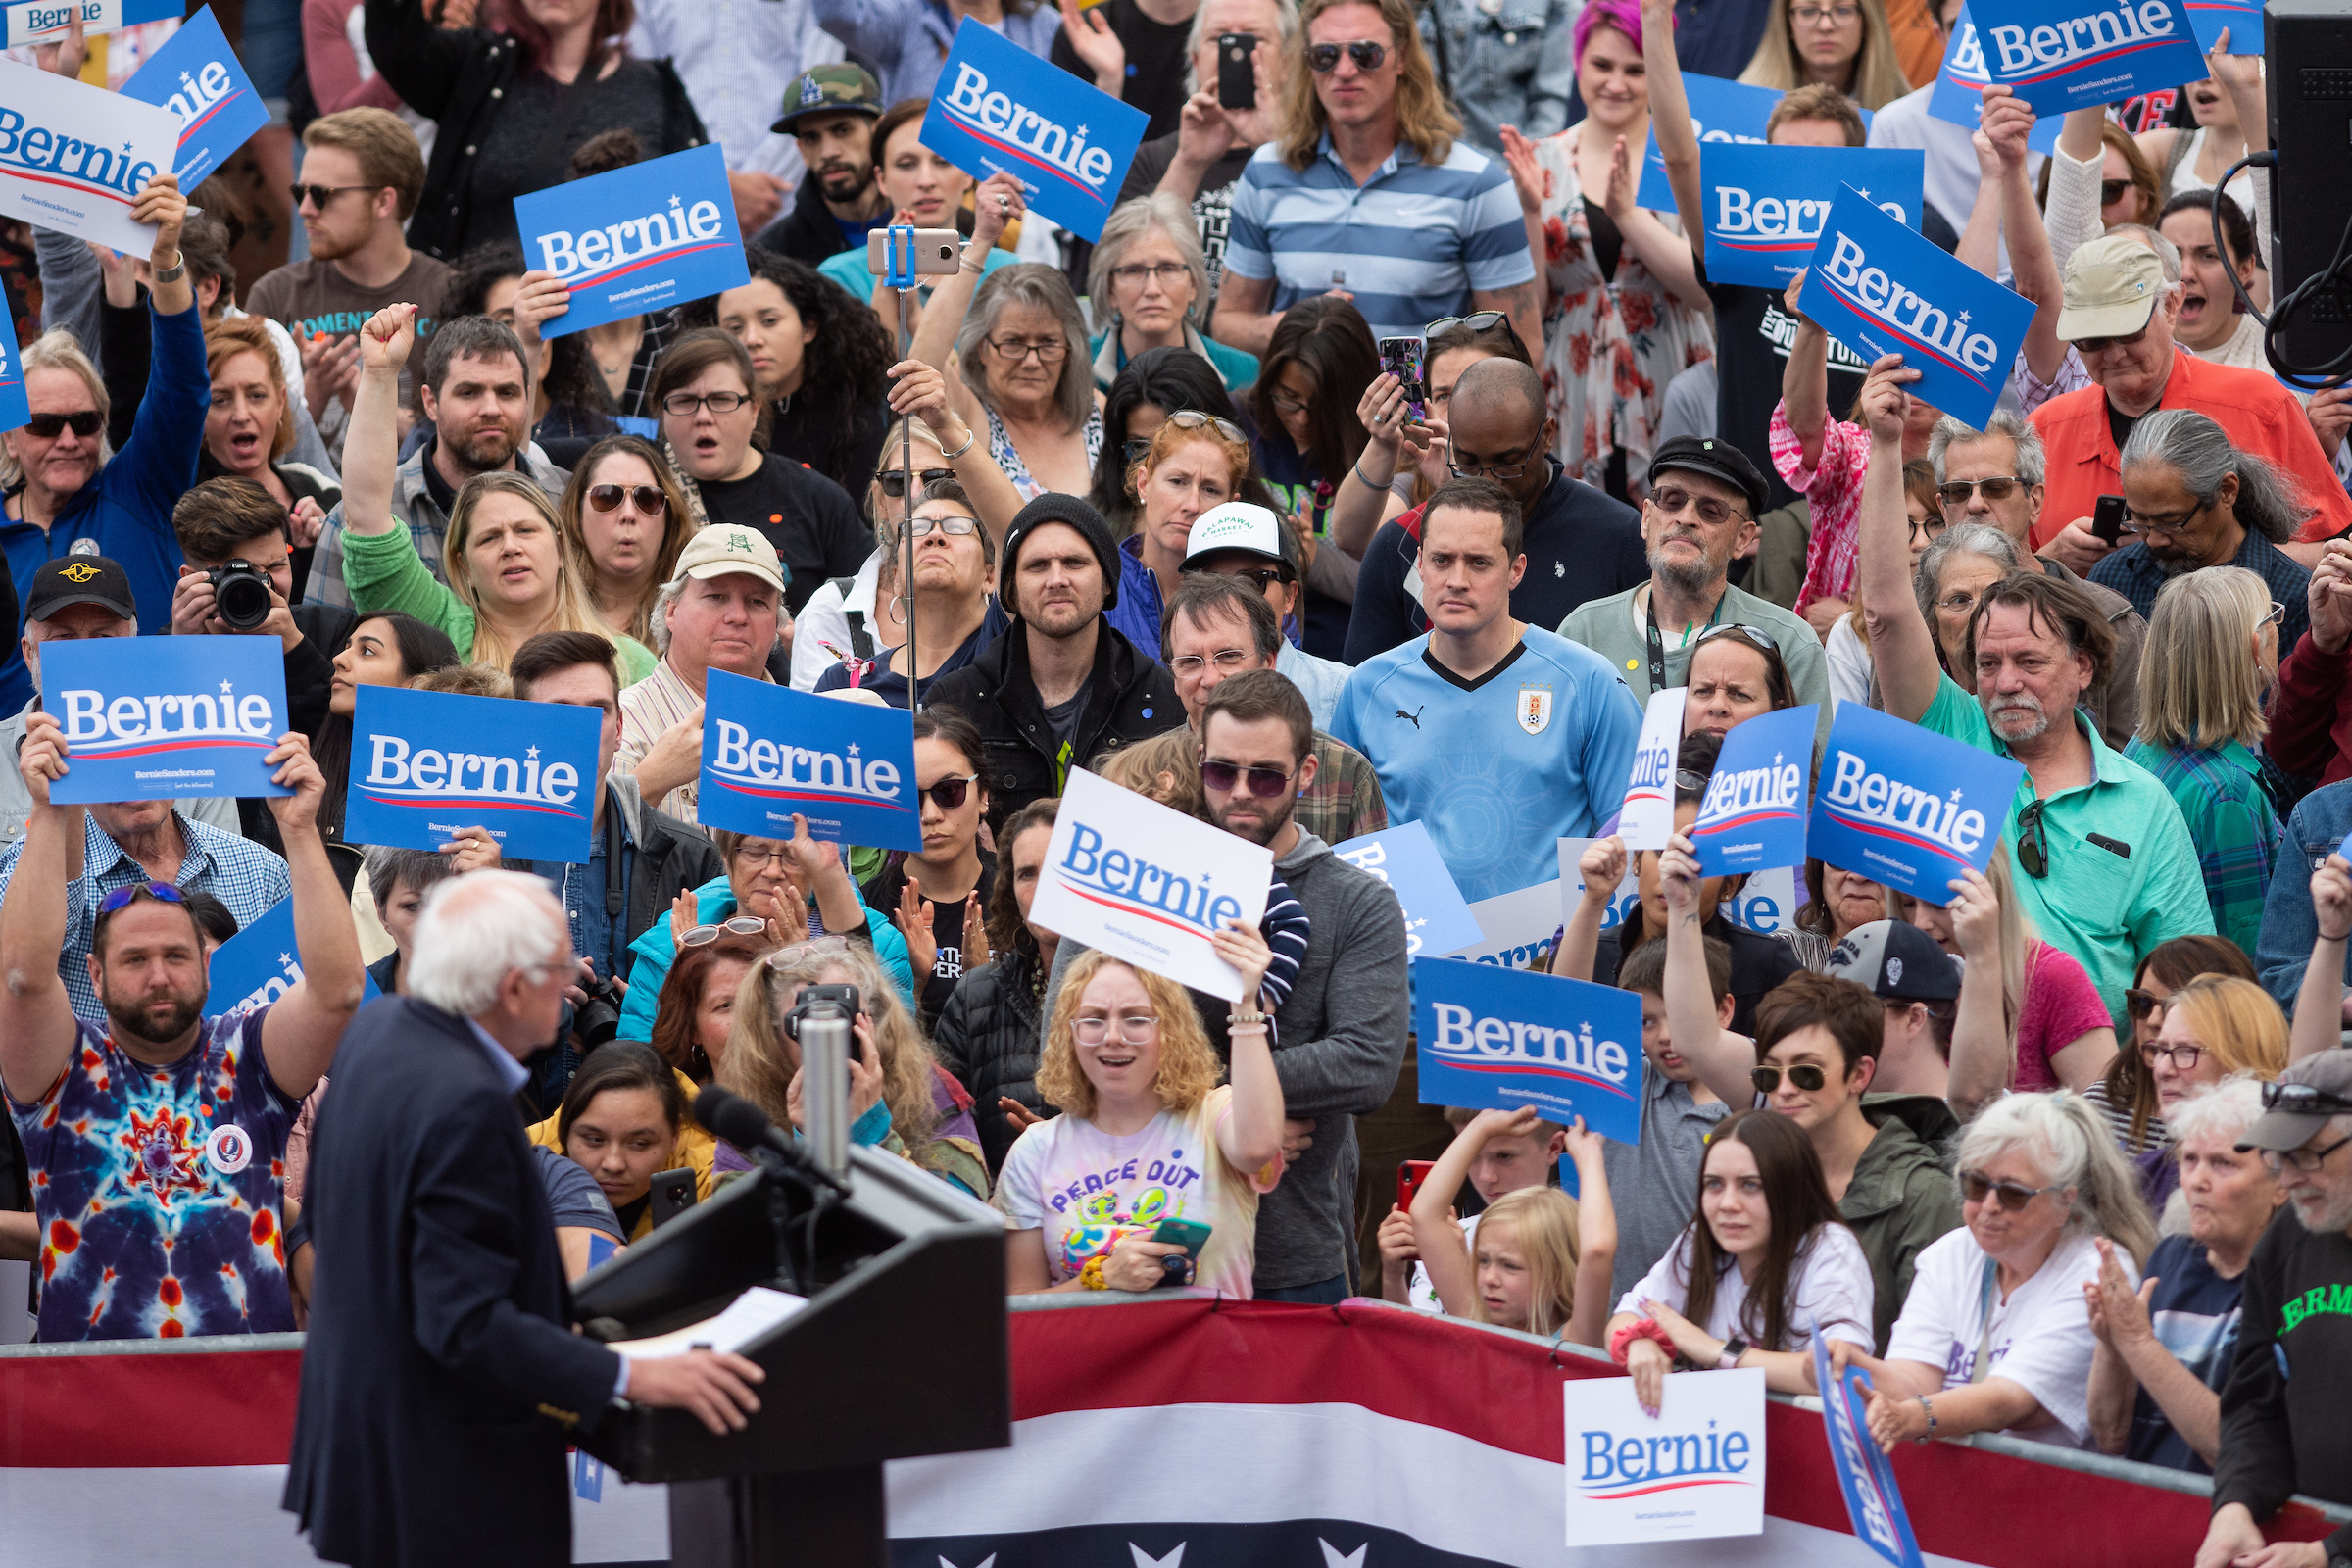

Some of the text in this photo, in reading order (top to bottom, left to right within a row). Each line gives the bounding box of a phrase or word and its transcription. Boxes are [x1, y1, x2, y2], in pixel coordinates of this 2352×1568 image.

[27, 0, 102, 28] Berie
[1989, 0, 2174, 72] Bernie
[161, 61, 231, 126] nie
[2067, 74, 2133, 93] BernieSanders.com
[0, 106, 157, 195] Bernie
[946, 61, 1113, 186] Bernie
[21, 193, 85, 219] BernieSanders.com
[536, 193, 722, 277] Bernie
[609, 278, 676, 303] BernieSanders.com
[1824, 230, 1997, 372] Bernie
[289, 311, 375, 339] OMENT
[1211, 525, 1242, 535] MARKET
[61, 678, 272, 741] Bernie
[135, 769, 215, 779] BernieSanders.com
[366, 734, 579, 804] Bernie
[714, 718, 900, 798] Bernie
[1632, 736, 1670, 789] rnie
[1698, 751, 1800, 819] Bernie
[428, 822, 507, 838] BernieScom
[1827, 750, 1986, 853] Bernie
[1061, 820, 1241, 932] Bernie
[1432, 1002, 1629, 1082] Bernie
[1051, 1158, 1200, 1213] PEACE OUT
[2277, 1283, 2352, 1337] ERM
[1581, 1417, 1750, 1481] Bernie
